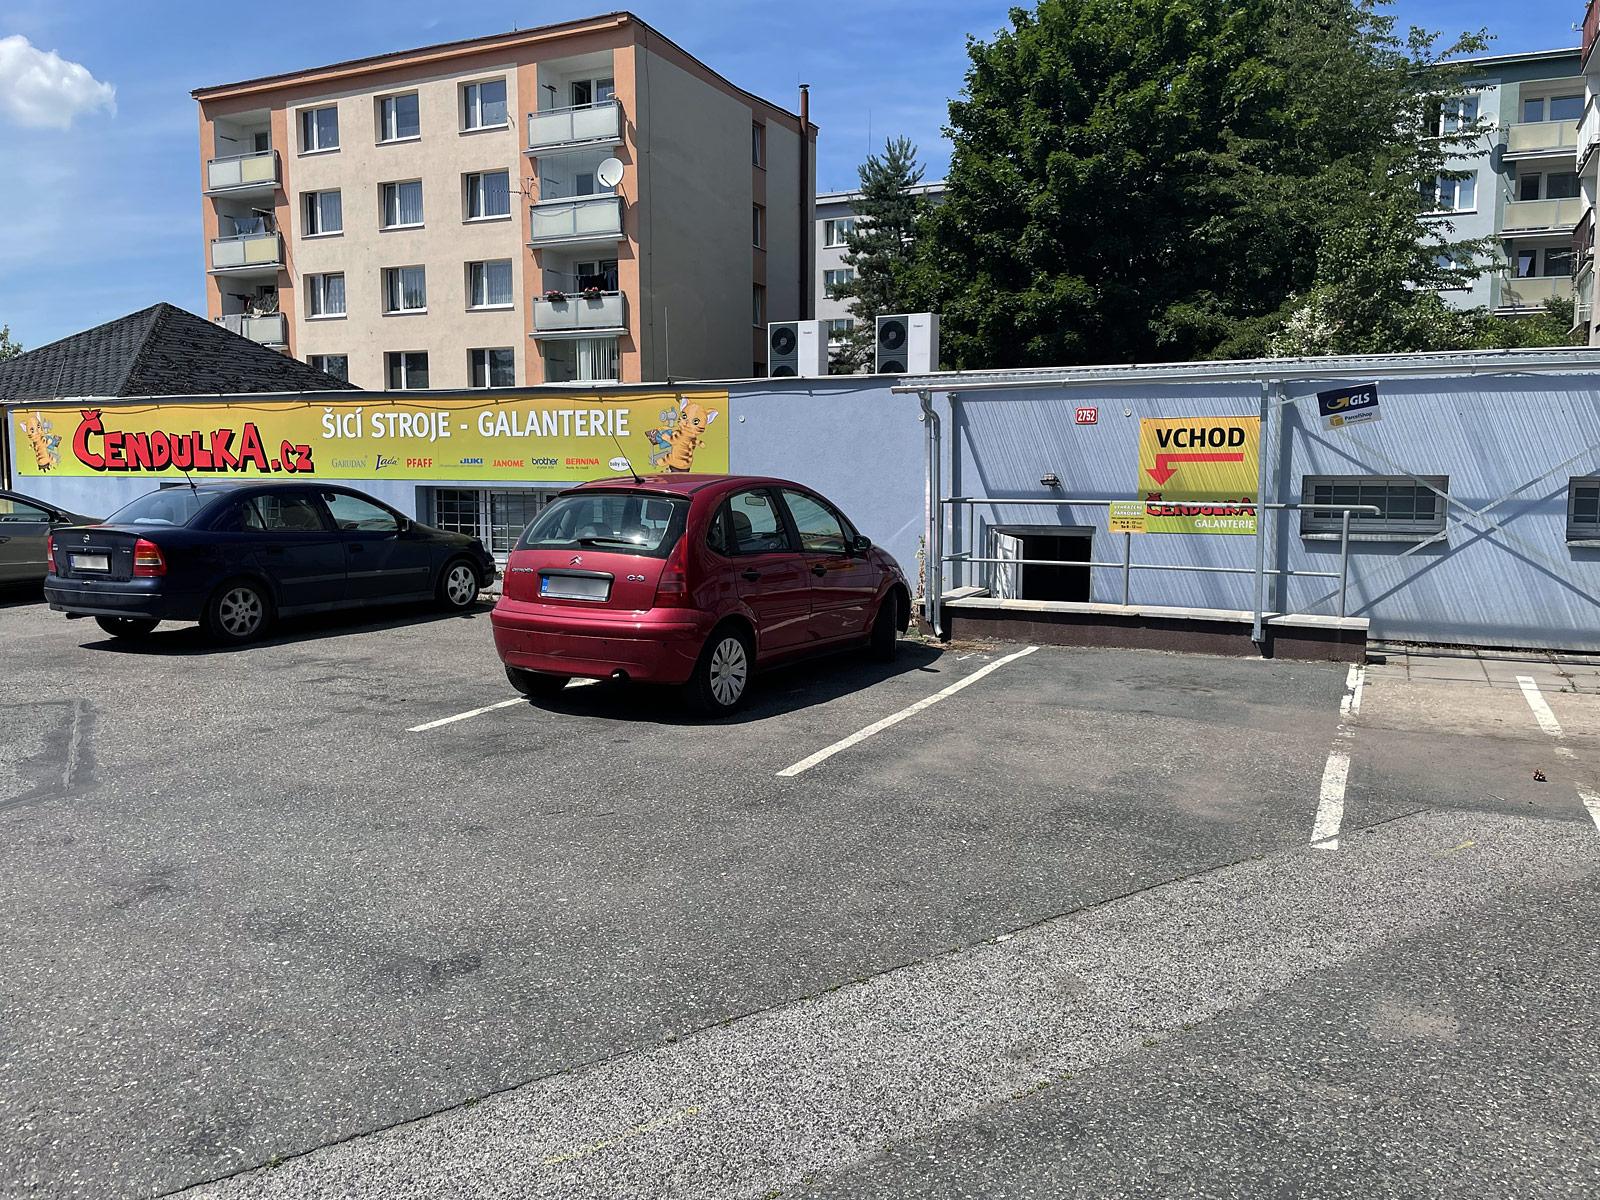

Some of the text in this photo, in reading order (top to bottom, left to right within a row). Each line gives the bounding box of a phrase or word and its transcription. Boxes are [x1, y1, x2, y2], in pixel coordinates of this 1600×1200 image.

[1350, 393, 1370, 406] GLS
[1077, 410, 1096, 422] 2752
[322, 406, 363, 438] ŠICÍ
[371, 411, 451, 442] STROJE
[477, 409, 630, 437] GALANTERIE
[1156, 427, 1246, 449] VCHOD
[331, 458, 367, 469] GARUDAN
[375, 454, 398, 471] Lada
[406, 458, 433, 468] PFAFF
[460, 457, 483, 465] JUKI
[492, 459, 525, 468] JANOME
[531, 457, 559, 466] brother
[565, 457, 600, 466] BERNINA
[1194, 519, 1255, 530] GALANTERIE
